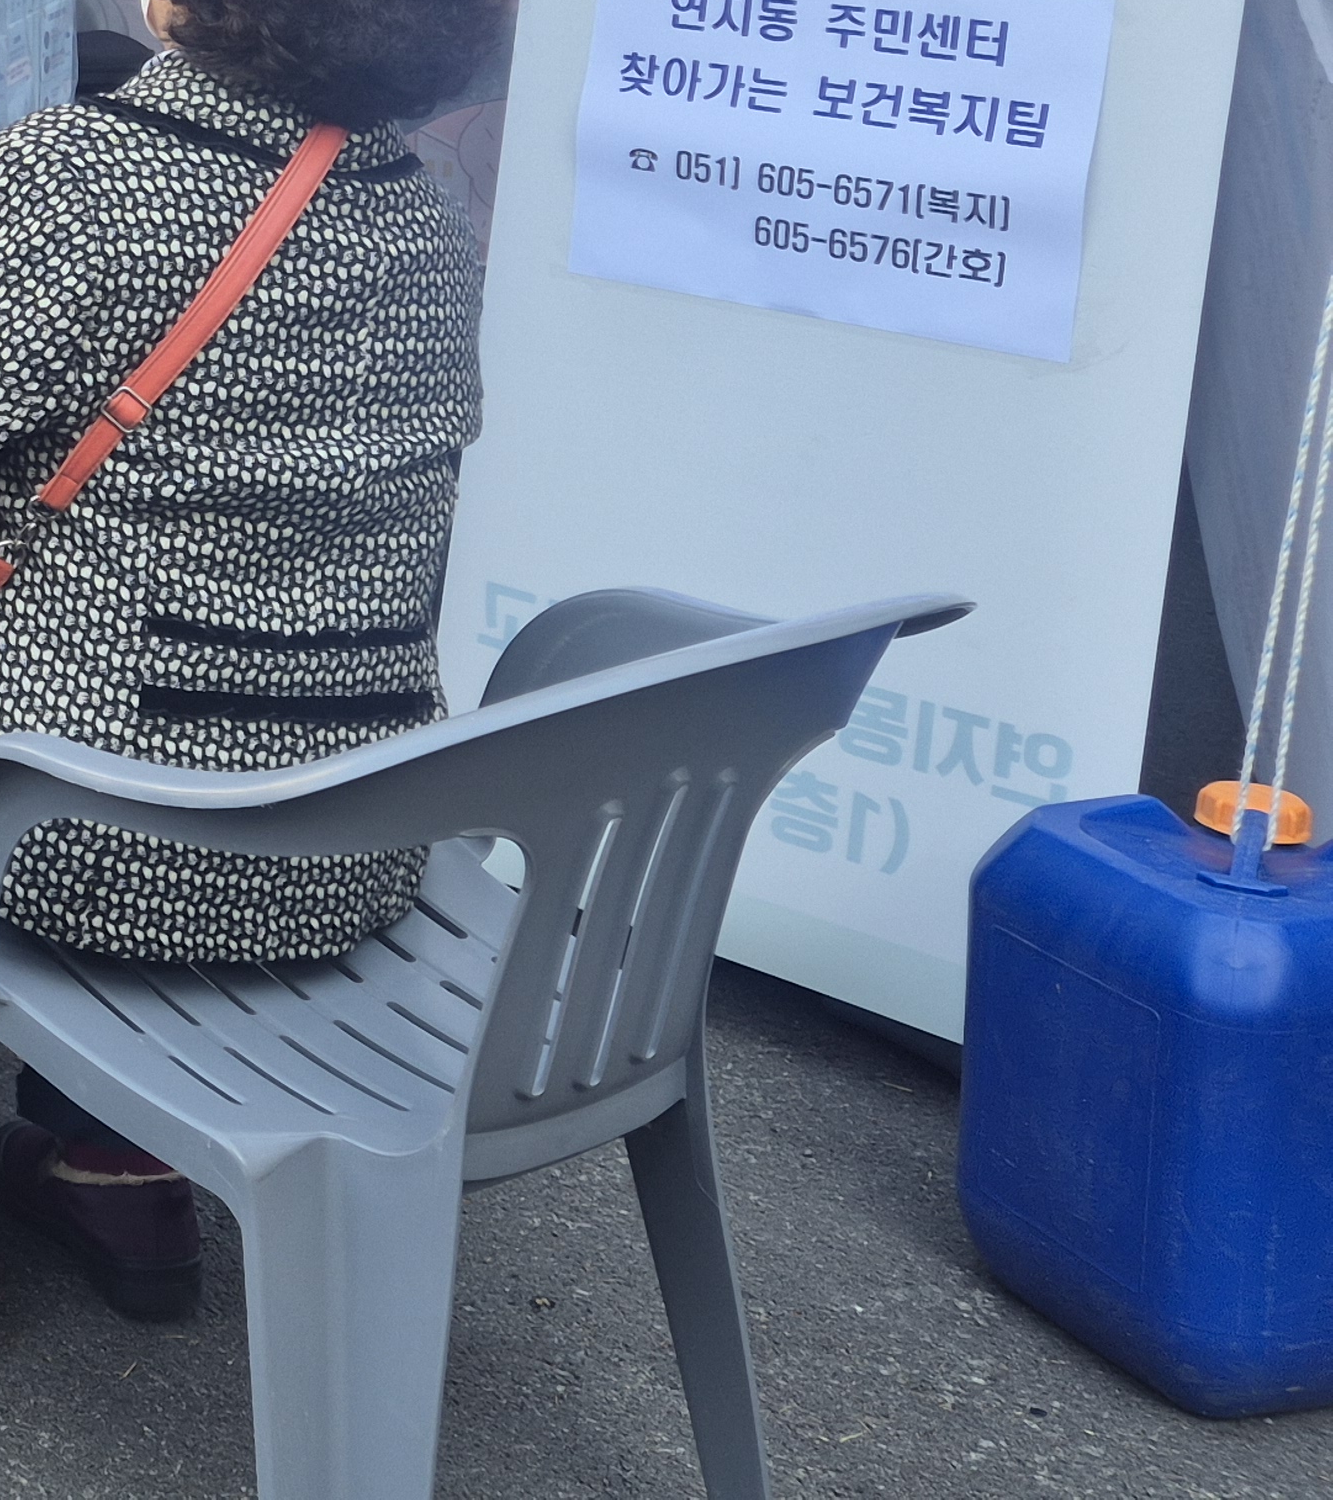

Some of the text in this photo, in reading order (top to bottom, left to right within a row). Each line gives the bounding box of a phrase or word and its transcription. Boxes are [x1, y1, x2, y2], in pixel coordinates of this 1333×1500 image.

[825, 2, 1011, 68] 주민센터
[618, 51, 1050, 150] 찾아가는 보건복지팀
